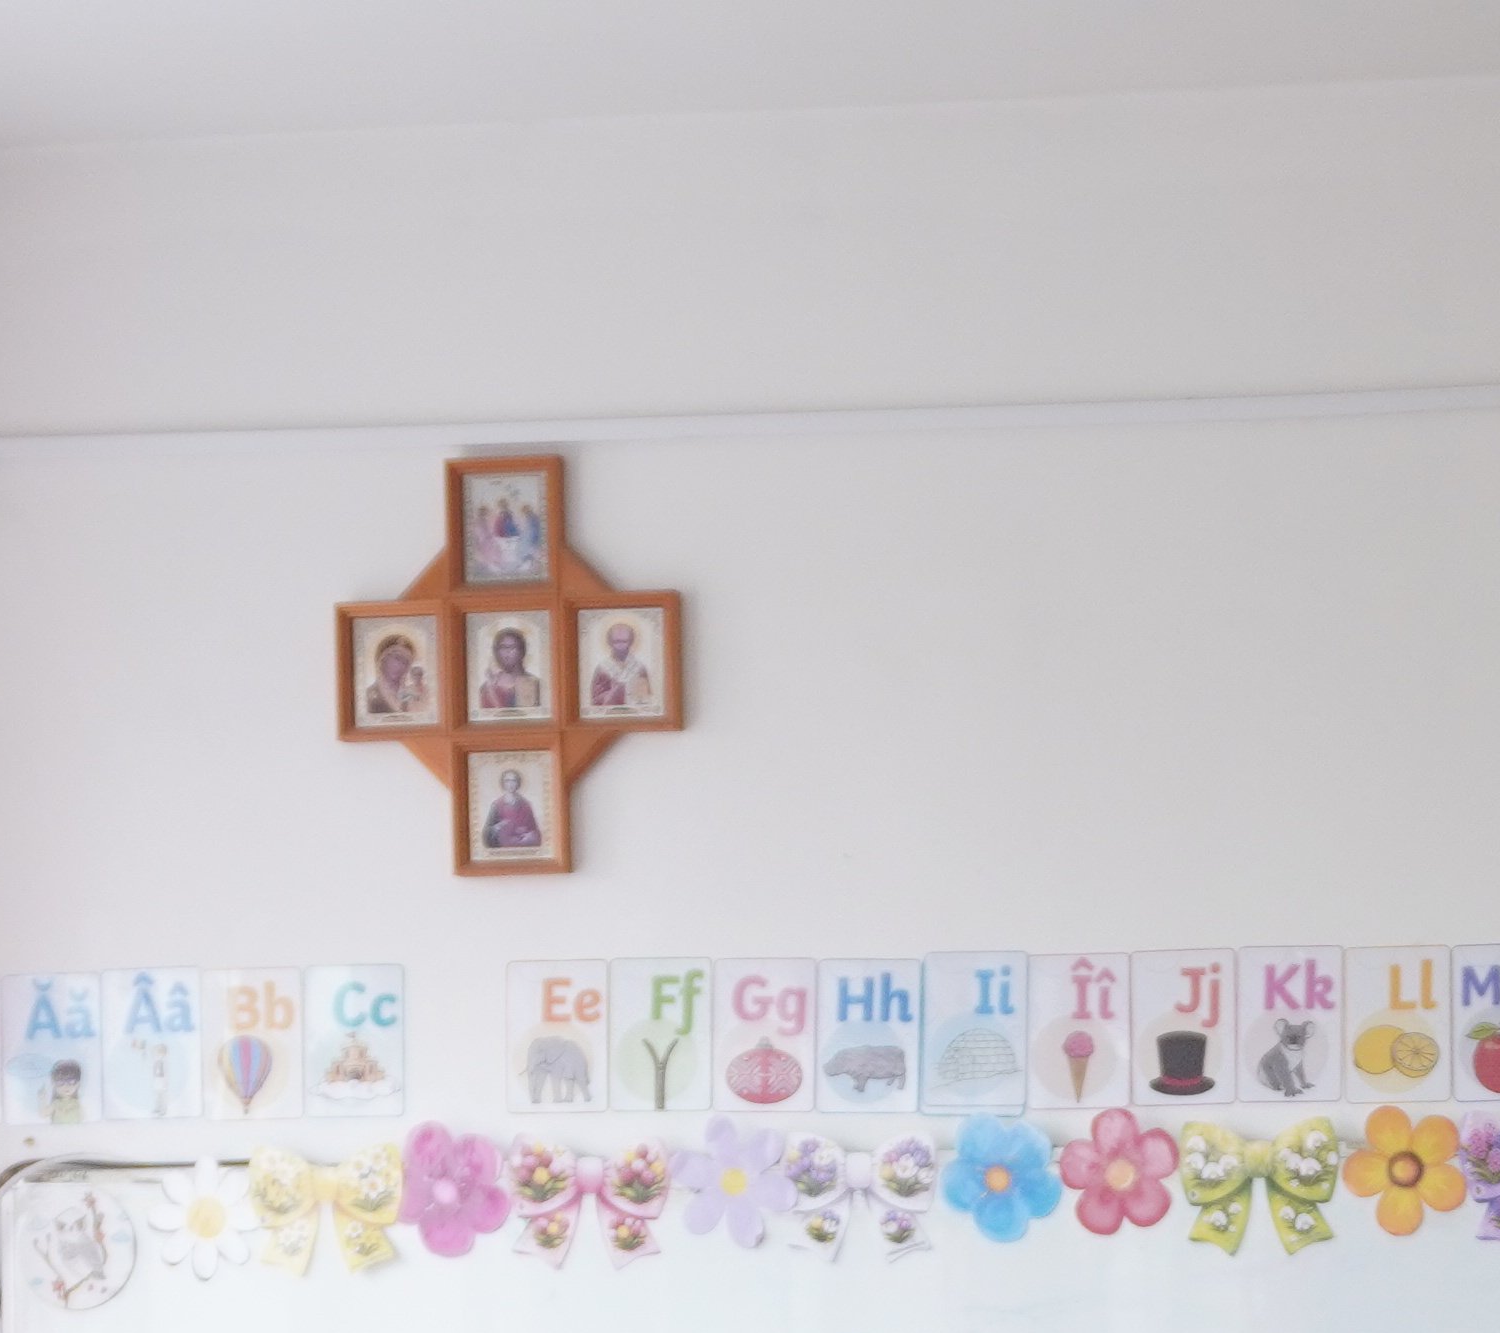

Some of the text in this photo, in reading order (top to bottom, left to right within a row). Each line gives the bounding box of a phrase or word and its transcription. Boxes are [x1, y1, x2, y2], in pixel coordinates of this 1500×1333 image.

[27, 977, 97, 1039] Ăă
[125, 972, 195, 1034] Ââ
[227, 981, 294, 1030] Bb
[334, 981, 398, 1028] Cc
[542, 977, 602, 1022] Ee
[650, 968, 705, 1035] Ff
[732, 975, 807, 1036] Gg
[836, 972, 913, 1021] Hh
[974, 965, 1014, 1015] Ii
[1071, 956, 1117, 1020] Îî
[1175, 963, 1220, 1028] Jj
[1264, 959, 1335, 1010] Kk
[1389, 959, 1438, 1010] Ll
